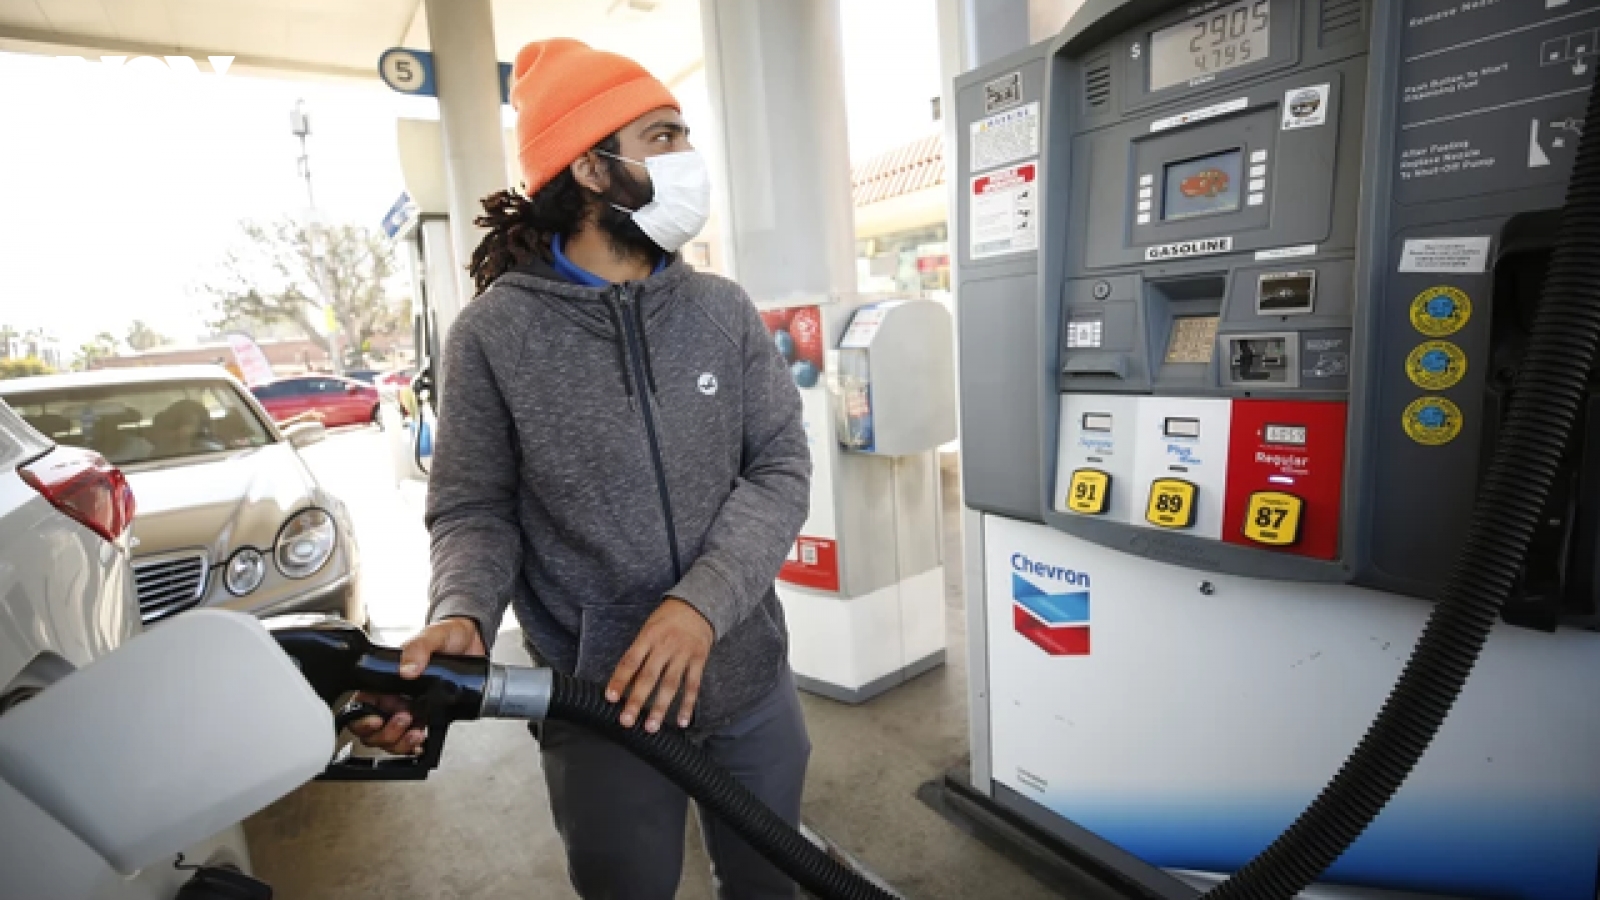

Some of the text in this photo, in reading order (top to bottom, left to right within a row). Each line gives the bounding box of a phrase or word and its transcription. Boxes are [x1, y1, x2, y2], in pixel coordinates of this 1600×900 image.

[1189, 0, 1269, 53] 2905
[1409, 8, 1456, 27] Remove
[394, 60, 413, 82] 5
[1149, 239, 1228, 259] GASOLINE
[1255, 451, 1309, 468] Regular
[1075, 482, 1096, 501] 91
[1156, 494, 1183, 513] 89
[1255, 507, 1288, 529] 87
[1010, 551, 1091, 588] Chevron
